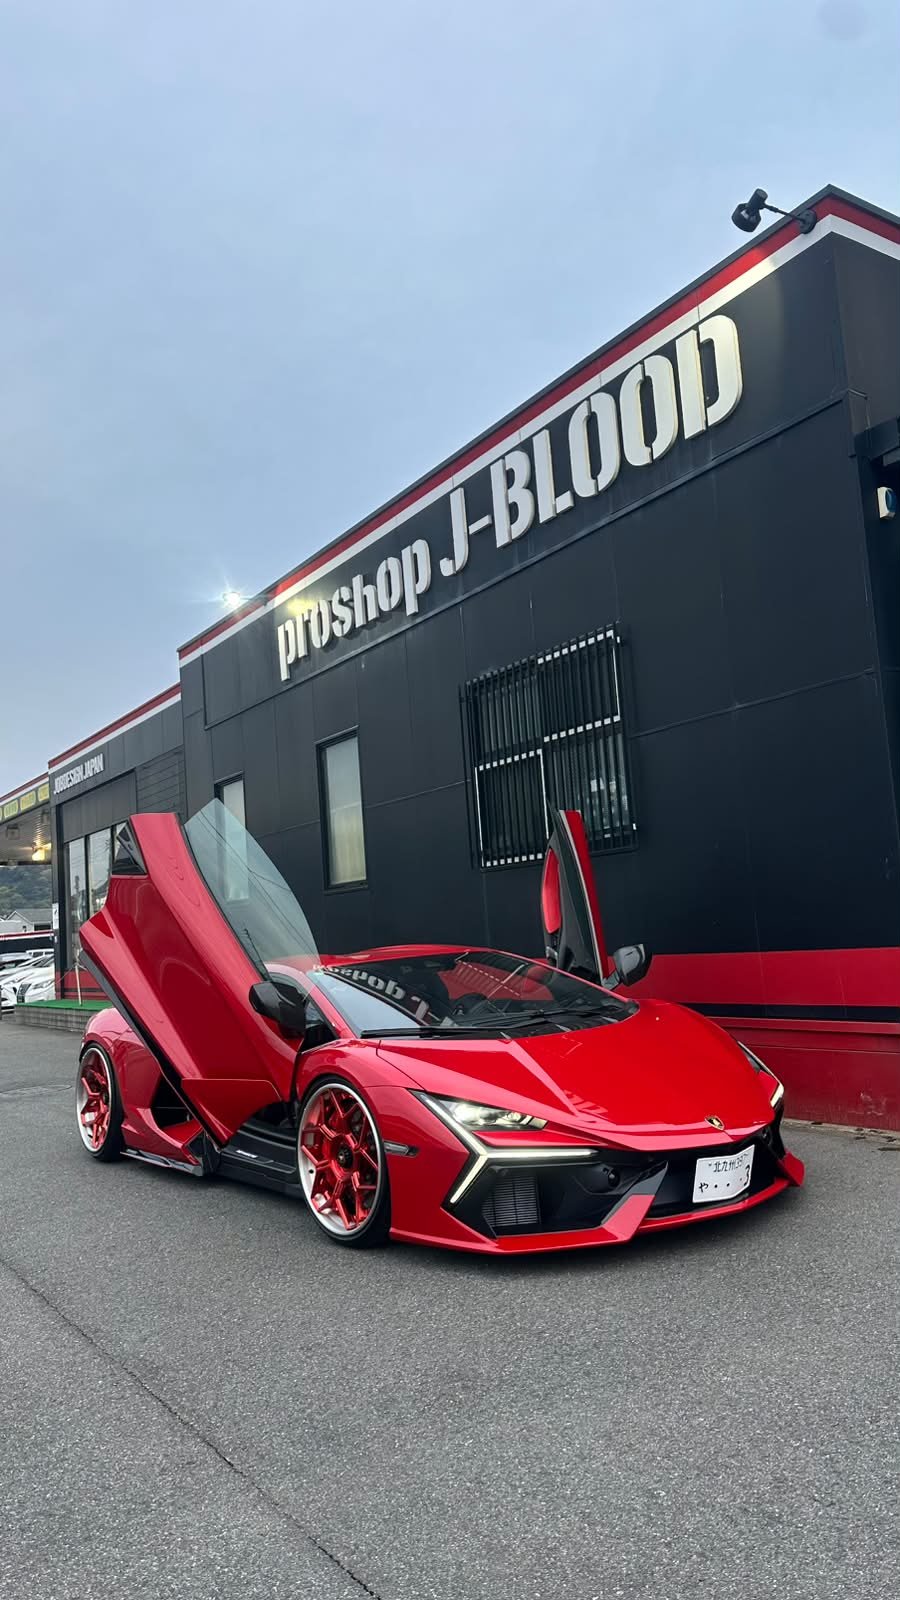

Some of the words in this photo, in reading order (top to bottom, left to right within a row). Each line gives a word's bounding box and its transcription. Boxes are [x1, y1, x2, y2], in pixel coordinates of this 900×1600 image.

[277, 538, 431, 681] proshop
[440, 314, 743, 578] J-BLOOD
[84, 753, 104, 780] JAPAN
